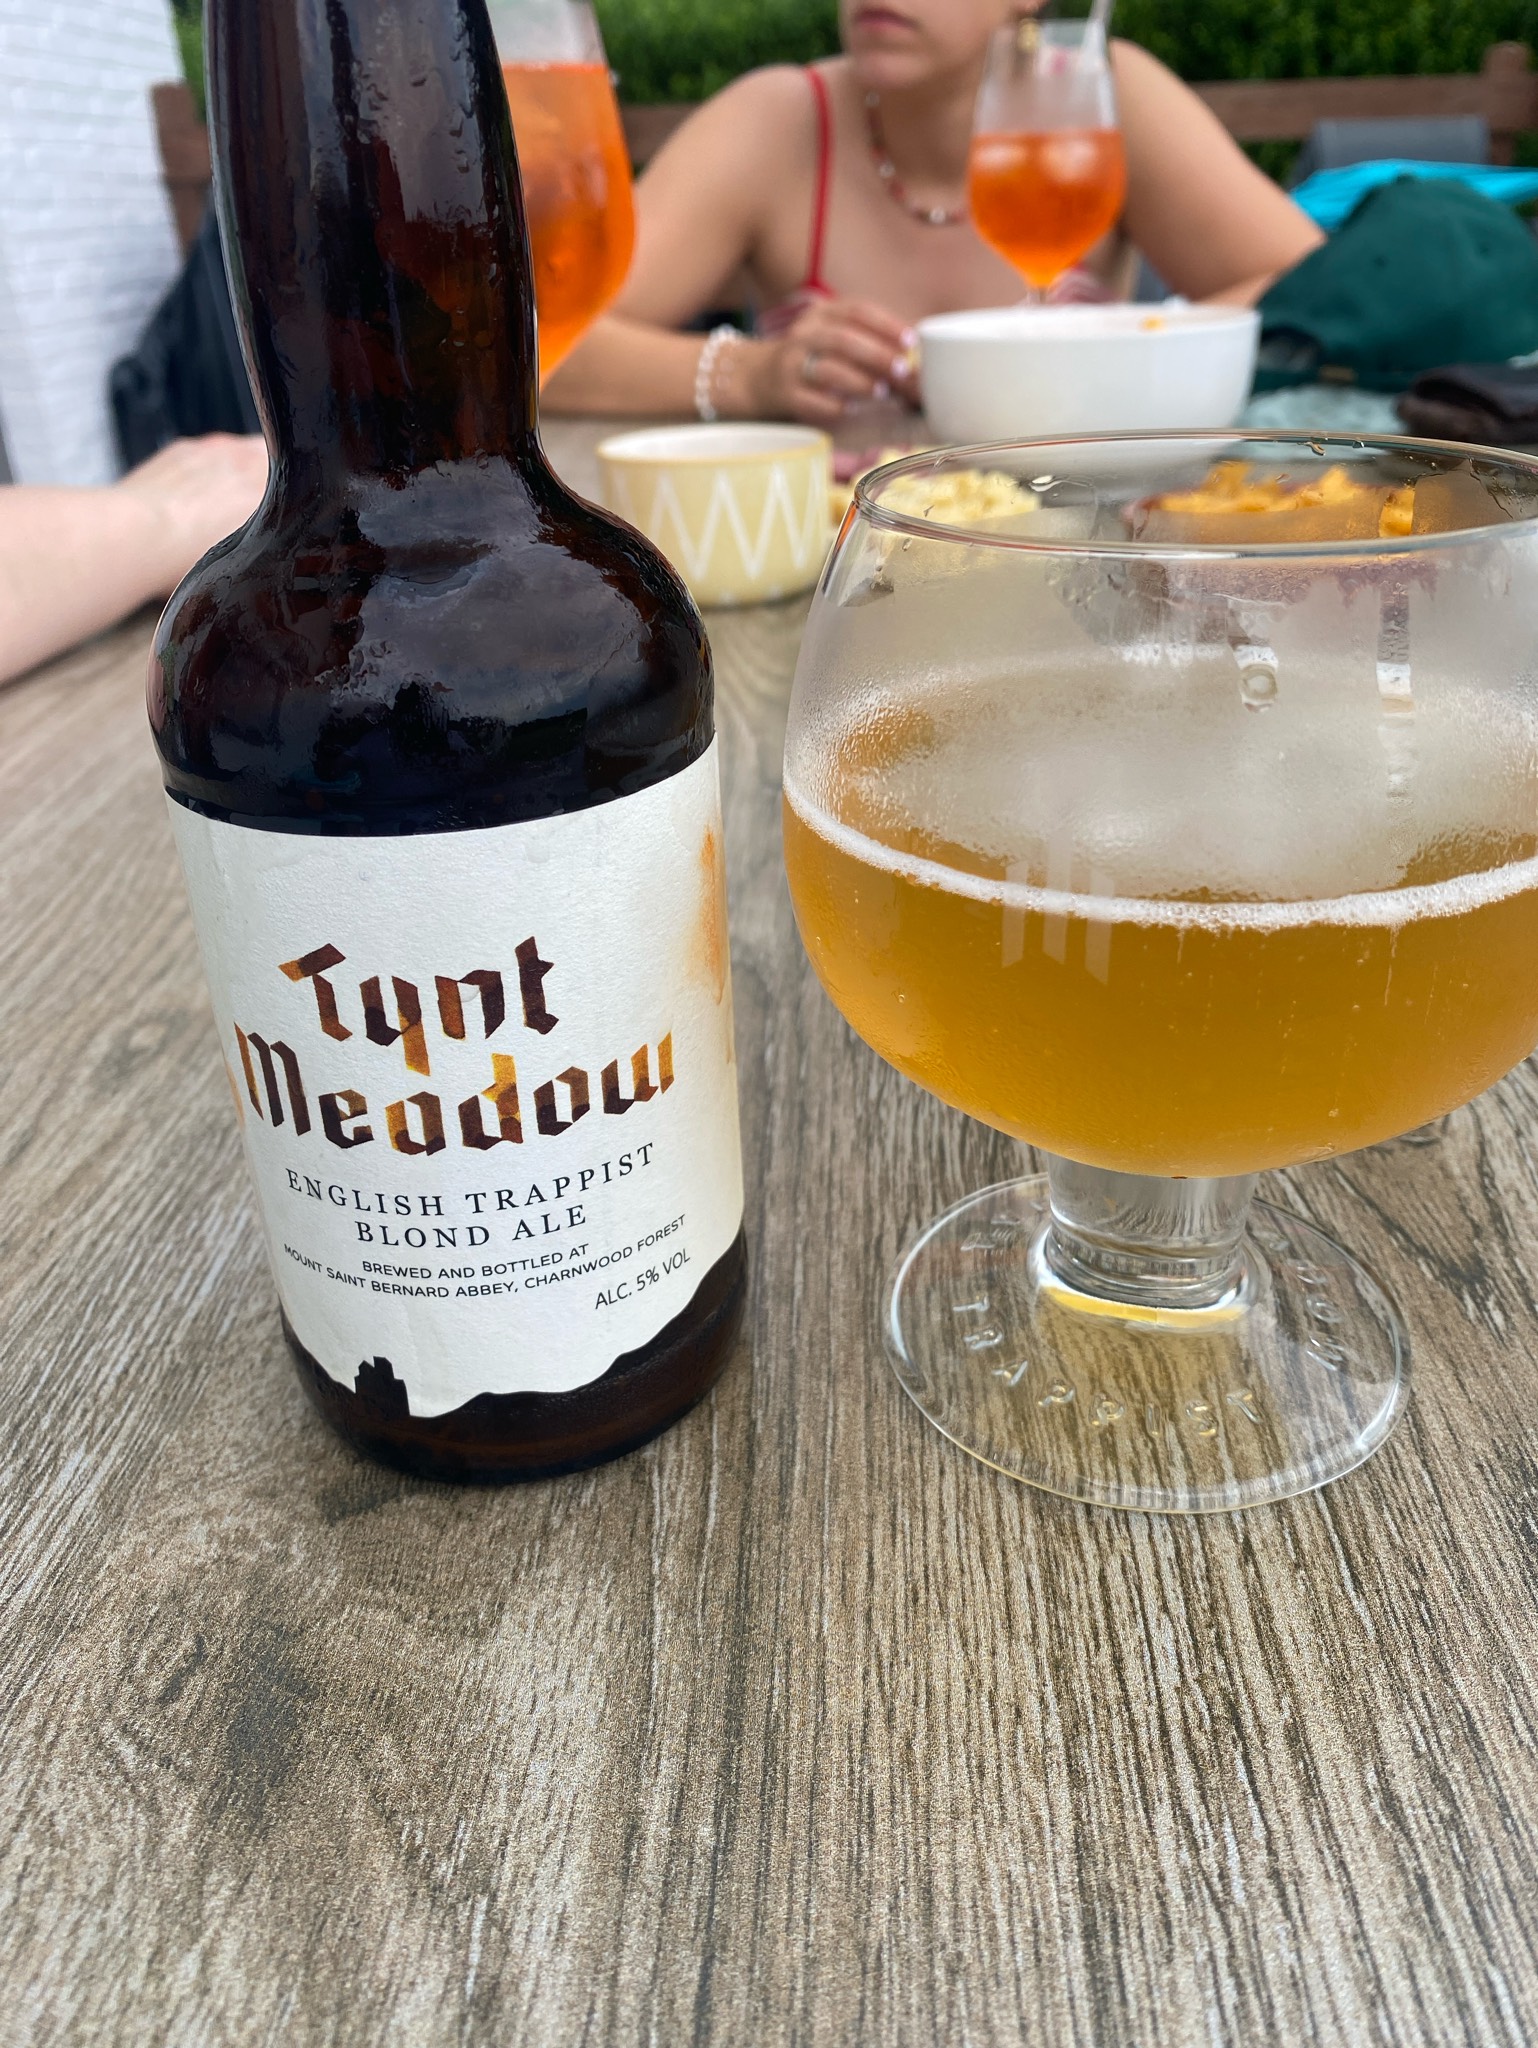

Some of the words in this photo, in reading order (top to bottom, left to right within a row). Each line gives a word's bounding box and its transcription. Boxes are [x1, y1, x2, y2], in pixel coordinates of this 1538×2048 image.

[234, 1021, 676, 1156] Meadow
[285, 1168, 444, 1216] ENGLISH
[465, 1142, 654, 1214] TRAPPIST
[284, 1243, 322, 1273] MOUNT
[326, 1267, 366, 1288] SAINT
[371, 1280, 449, 1298] BERNARD
[455, 1281, 518, 1297] ABBEY,
[524, 1246, 633, 1289] CHARNWOOD
[637, 1214, 686, 1252] FOREST
[355, 1221, 490, 1249] BLOND
[512, 1204, 586, 1241] ALE
[362, 1261, 432, 1279] BREWED
[438, 1267, 475, 1279] AND
[482, 1252, 563, 1277] BOTTLED
[569, 1243, 589, 1260] AT
[594, 1282, 632, 1310] ALC.
[636, 1266, 660, 1292] 5%
[662, 1248, 691, 1275] VOL
